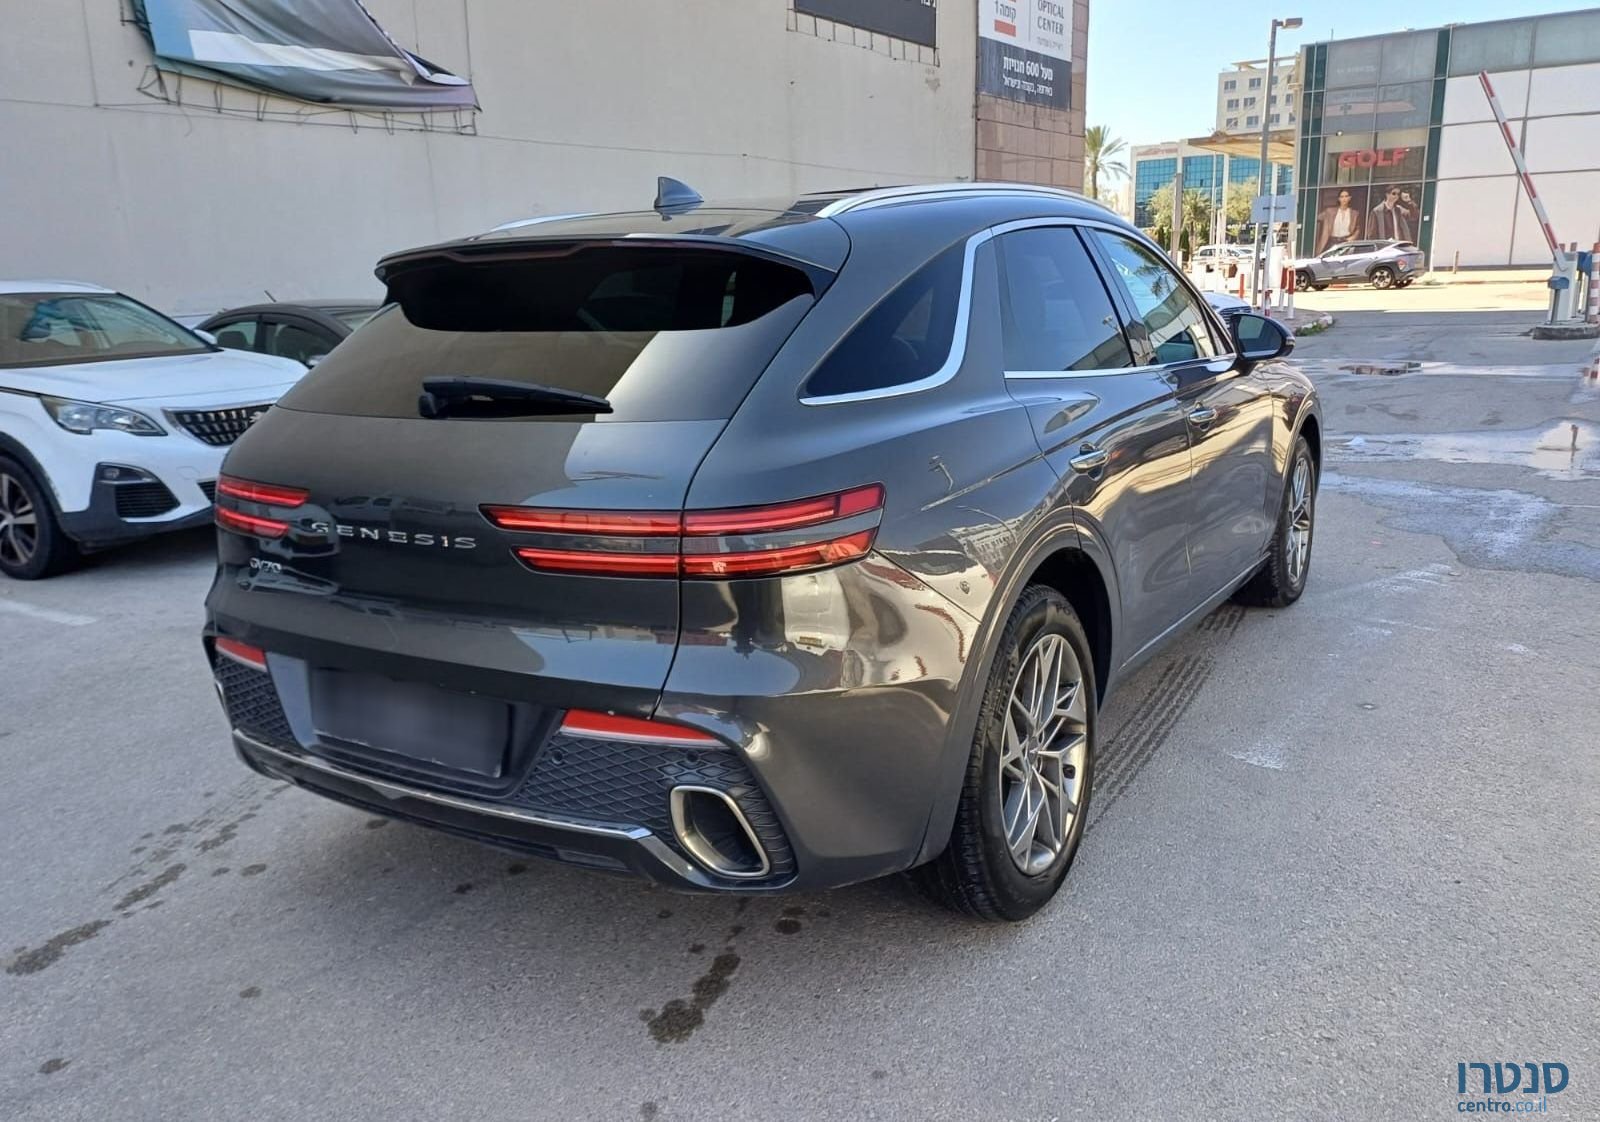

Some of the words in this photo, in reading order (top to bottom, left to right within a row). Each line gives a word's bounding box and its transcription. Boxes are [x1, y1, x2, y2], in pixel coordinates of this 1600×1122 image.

[1000, 4, 1016, 23] קומה
[1037, 0, 1064, 19] OPTICAL
[1037, 16, 1064, 35] CENTER
[1003, 56, 1025, 74] חנויות
[1026, 60, 1039, 78] 600
[1040, 63, 1053, 81] מעל
[1338, 146, 1408, 167] GOLF
[311, 521, 477, 549] GENESIS
[250, 557, 282, 574] GV70
